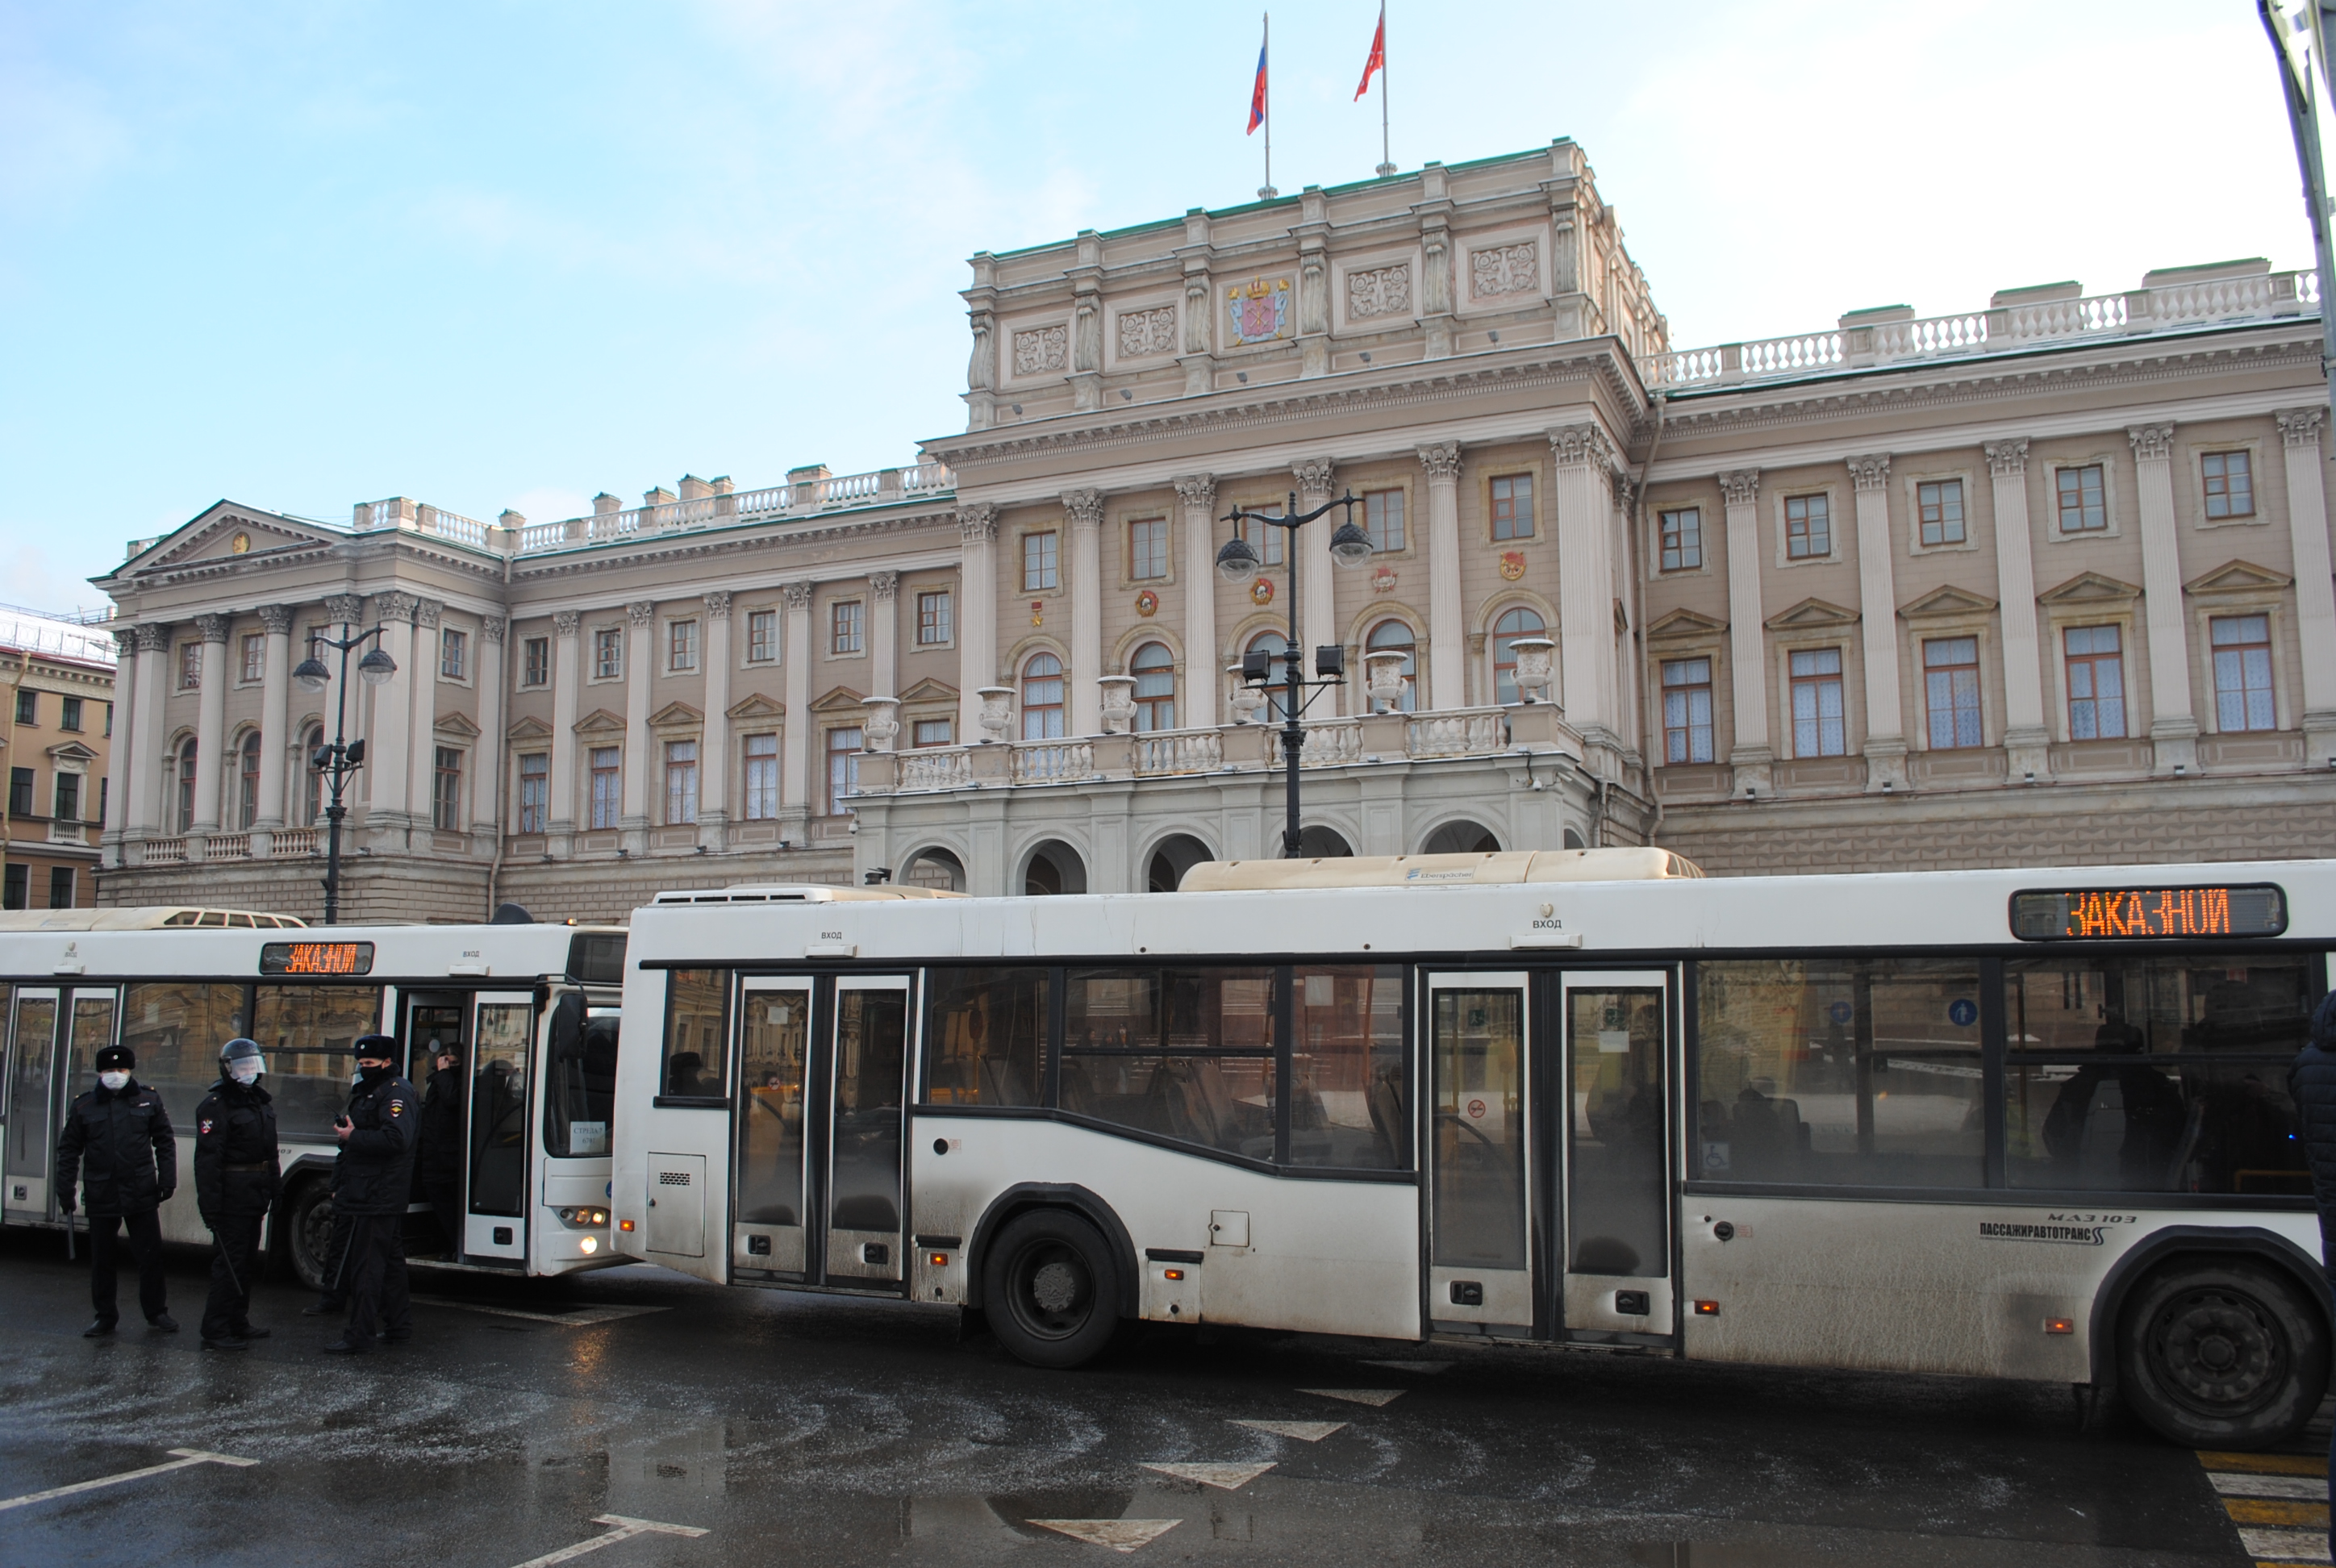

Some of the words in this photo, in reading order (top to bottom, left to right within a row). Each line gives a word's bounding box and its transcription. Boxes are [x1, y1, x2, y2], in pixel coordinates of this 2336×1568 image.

[2065, 889, 2230, 936] ЗАКАЗНОЙ
[1533, 920, 1562, 929] ВХОД
[821, 932, 842, 940] ВХОД
[285, 944, 357, 973] ЗАКАЗНОЙ
[2048, 1213, 2096, 1222] МАЗ
[2102, 1215, 2137, 1224] 103
[1980, 1222, 2091, 1241] ПАССАЖИРАВТОТРАНС
